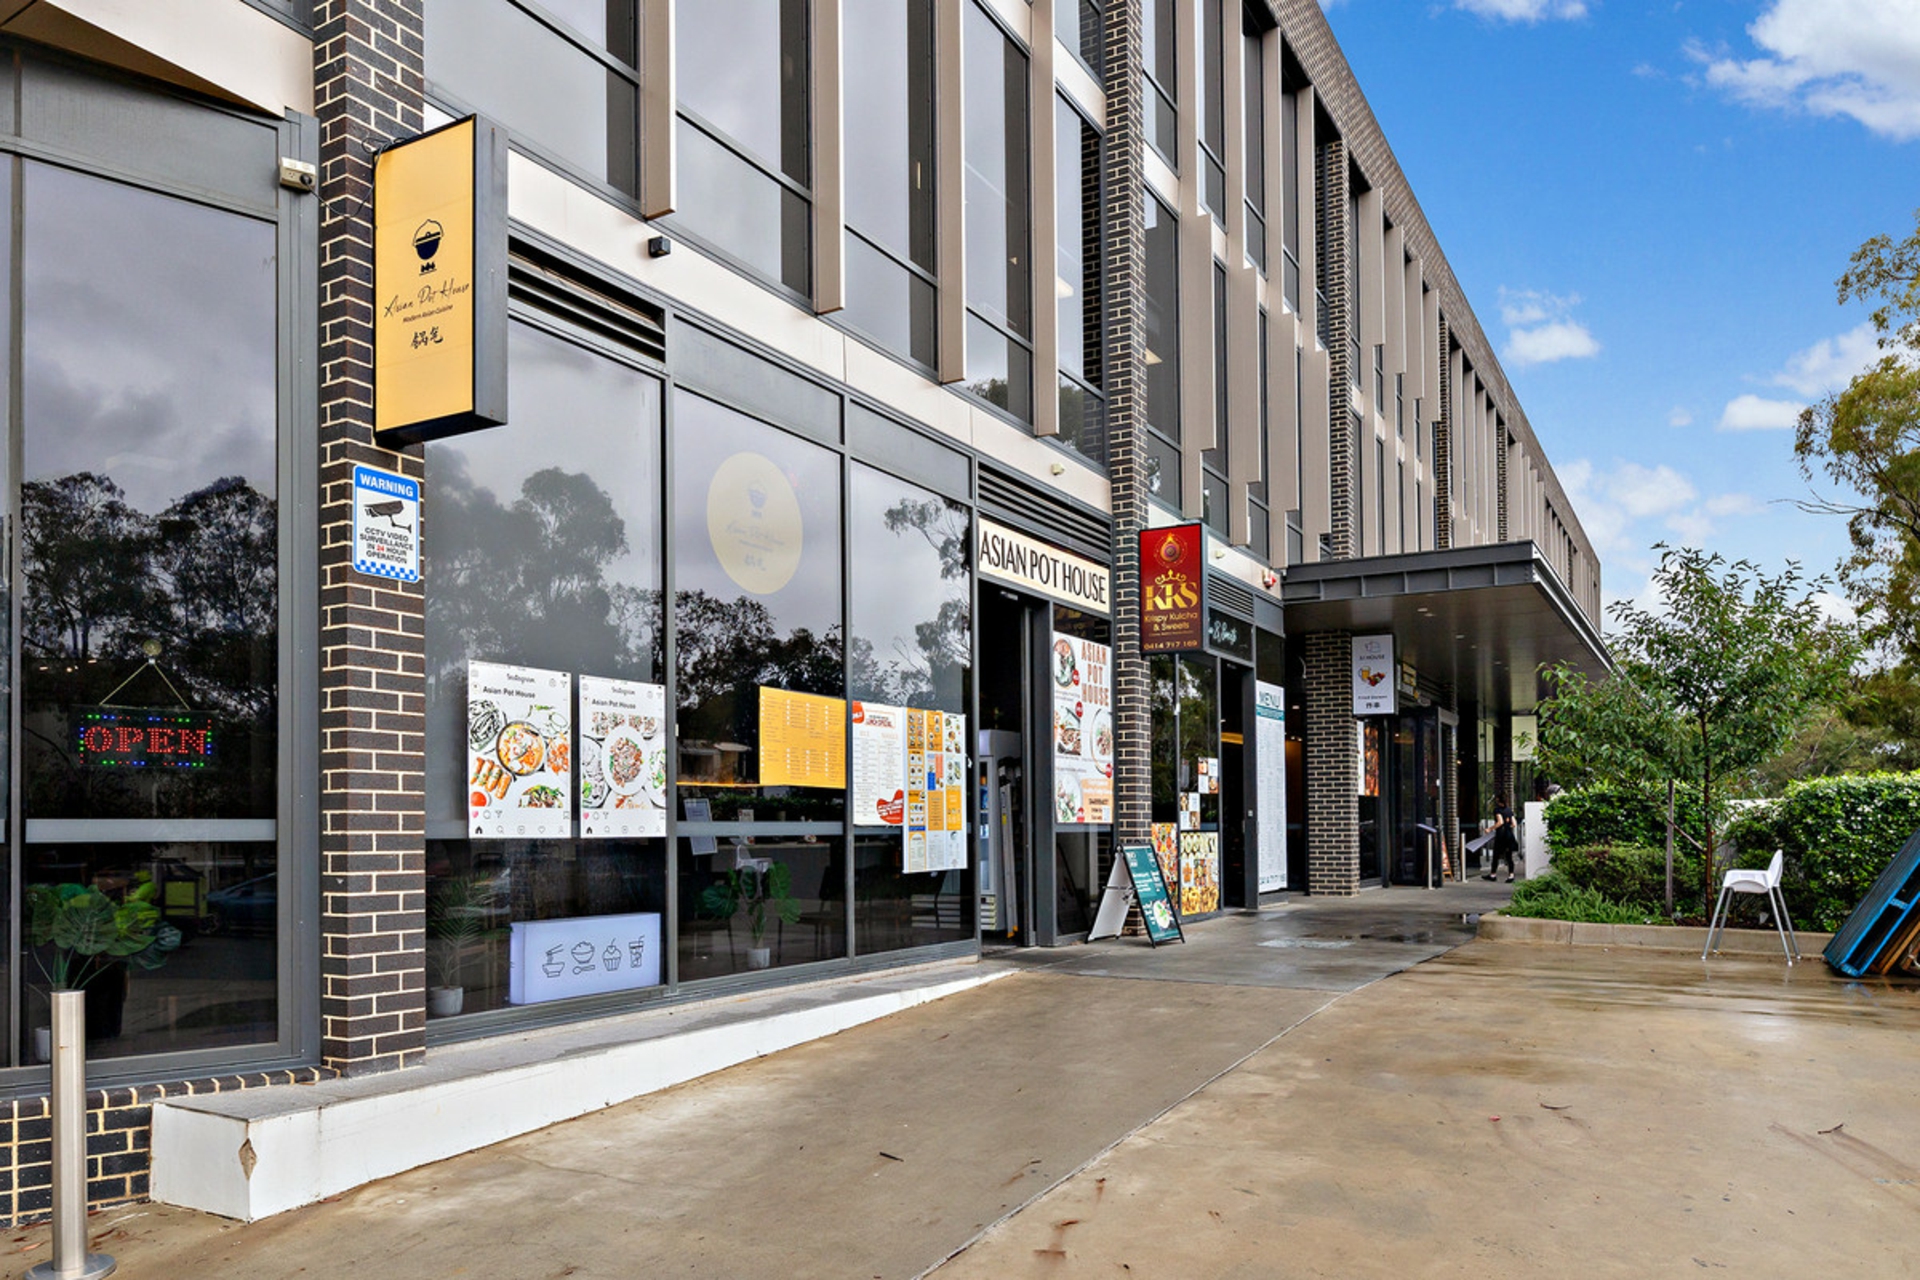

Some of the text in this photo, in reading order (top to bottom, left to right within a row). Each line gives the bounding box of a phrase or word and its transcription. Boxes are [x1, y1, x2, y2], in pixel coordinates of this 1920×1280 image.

[383, 294, 414, 318] Asian
[417, 284, 438, 305] Pot
[359, 473, 414, 497] WARNING
[359, 533, 414, 551] SURVEILLANCE
[364, 526, 409, 542] CCTV VIDEO
[366, 542, 407, 557] IN 24 HOUR
[366, 550, 407, 564] OPERATION
[980, 530, 1107, 605] ASIAN POT HOUSE
[1144, 582, 1199, 612] KKS
[1143, 612, 1198, 623] Krispy Kulcha
[1153, 621, 1190, 631] & Sweets
[1081, 641, 1107, 666] ASIAN
[1087, 663, 1103, 685] POT
[483, 686, 536, 699] Asian Pot House
[1081, 683, 1109, 707] HOUSE
[609, 700, 618, 708] Pot
[84, 726, 207, 755] OPEN
